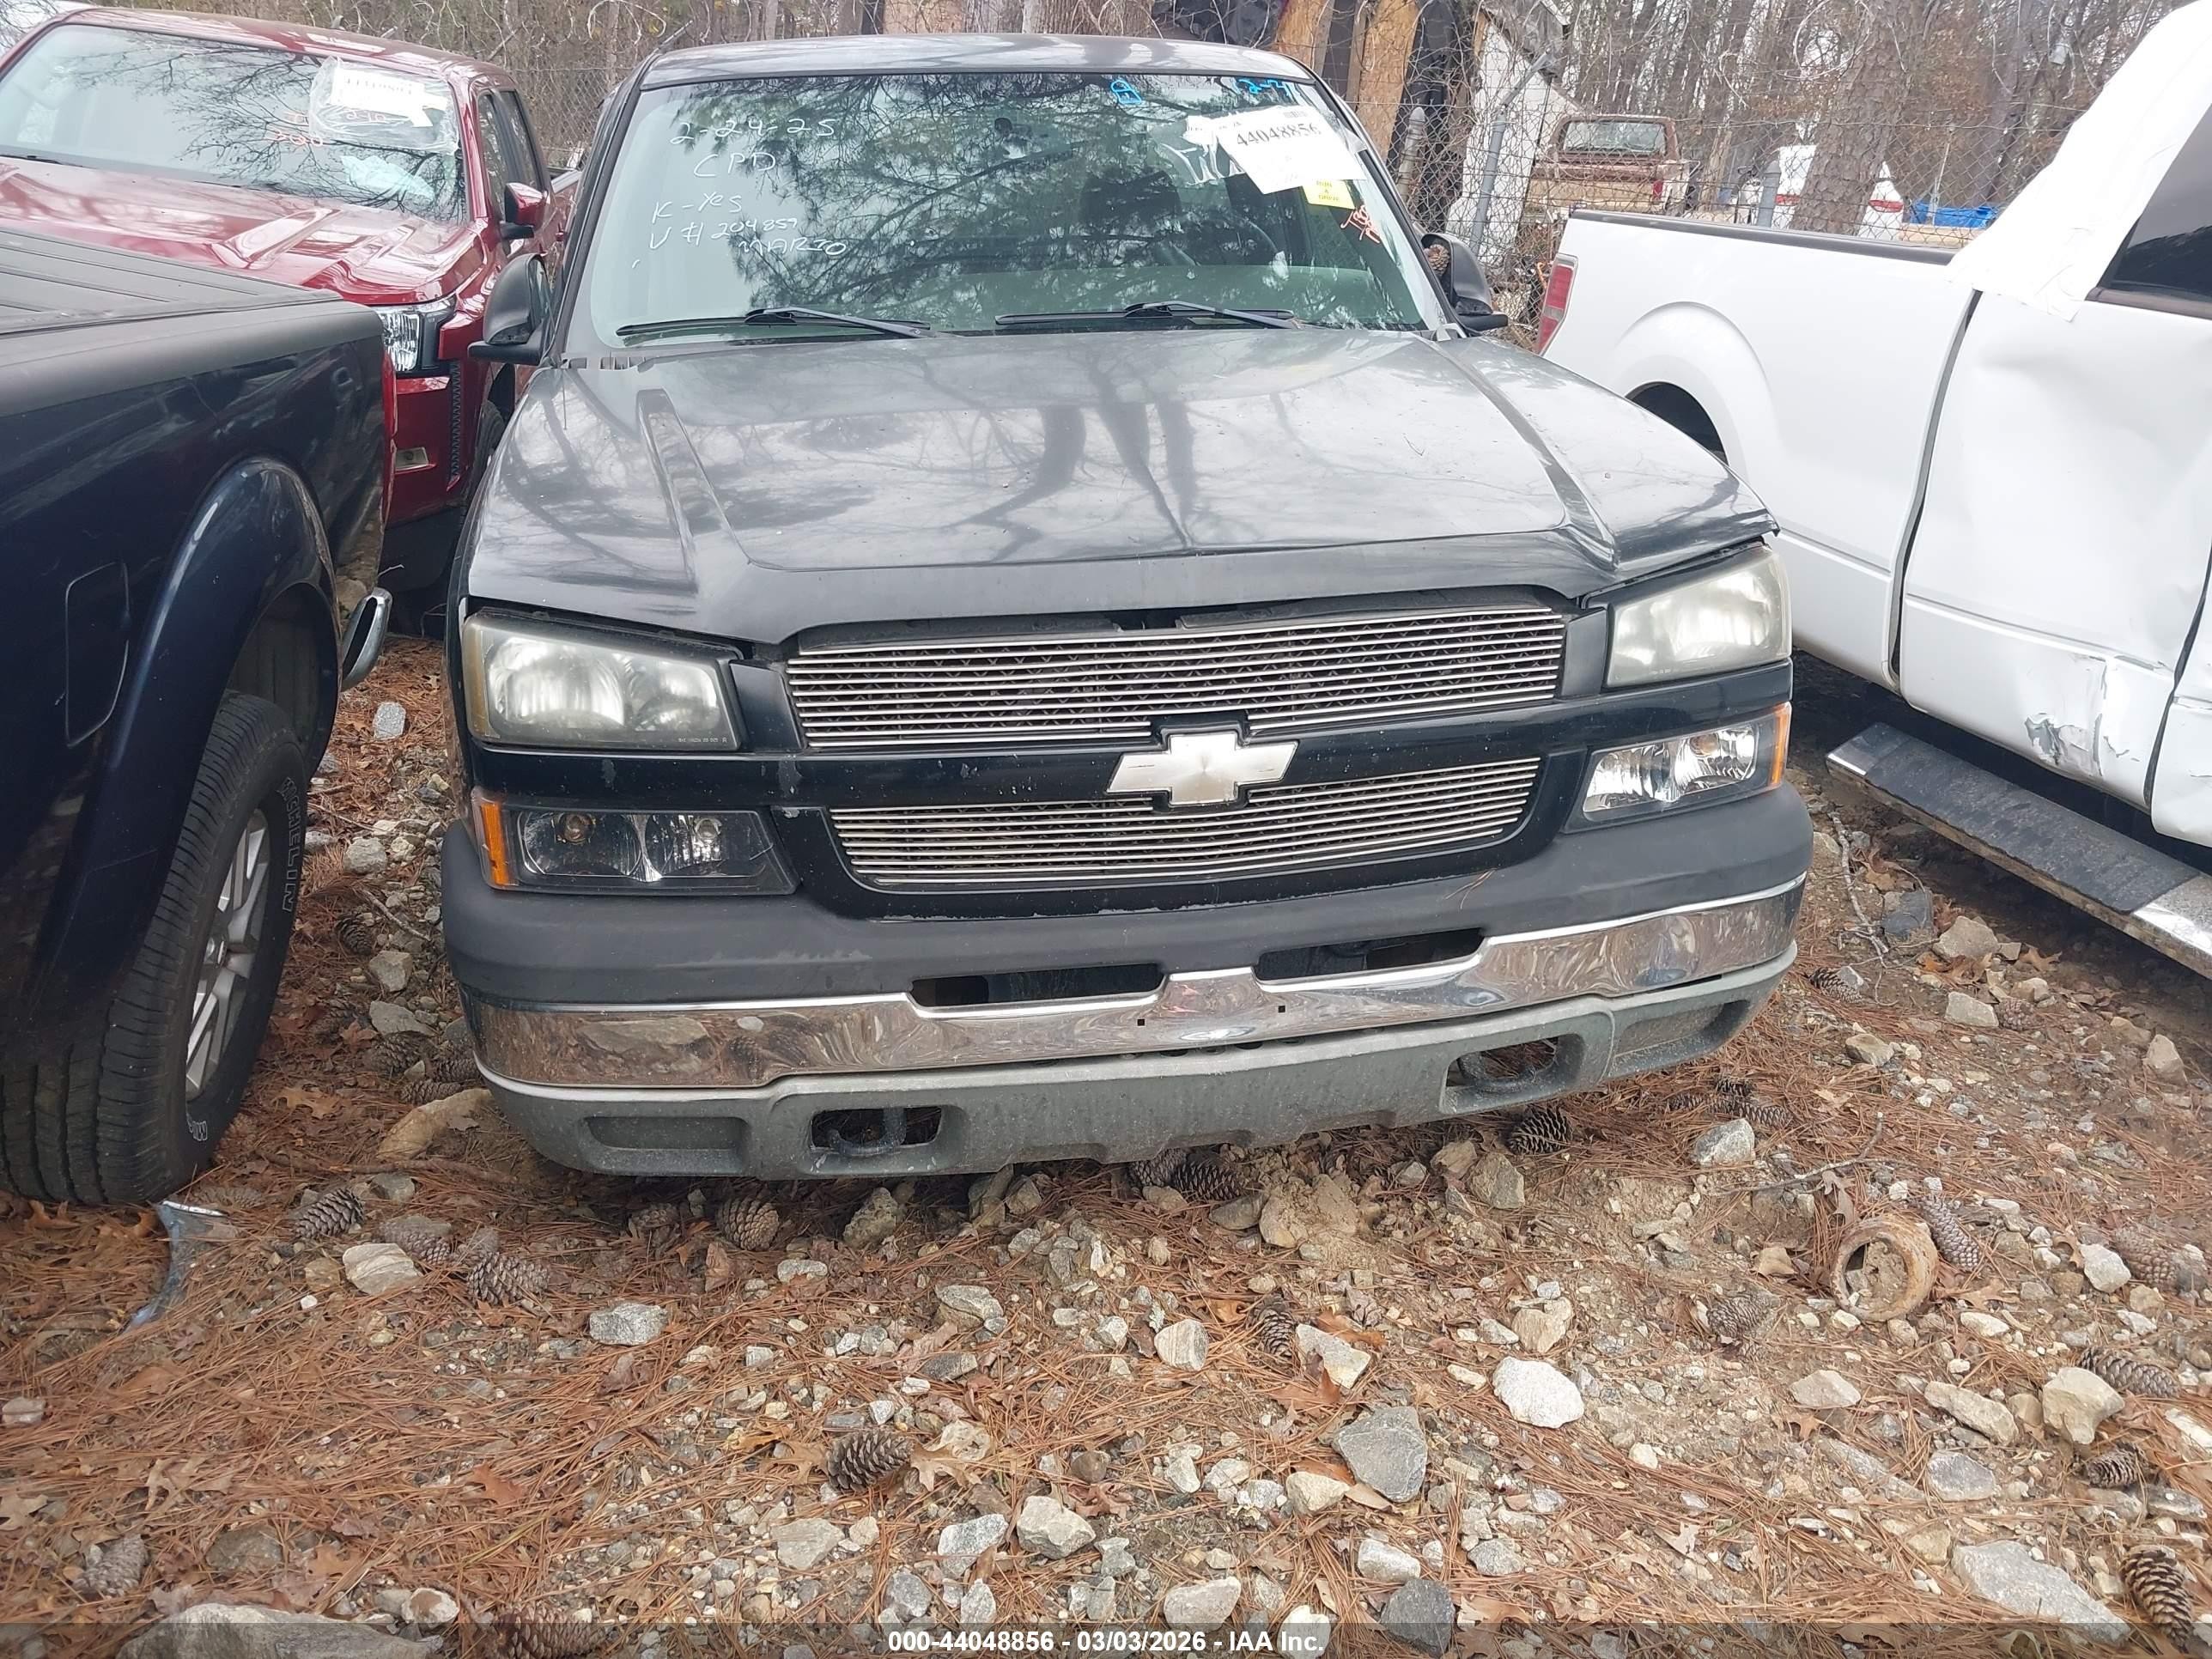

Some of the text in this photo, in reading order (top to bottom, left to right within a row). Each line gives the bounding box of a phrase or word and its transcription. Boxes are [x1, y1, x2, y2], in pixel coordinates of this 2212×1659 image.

[670, 118, 836, 144] 2-24-25
[1237, 122, 1322, 147] 44048856
[693, 152, 776, 177] CPD
